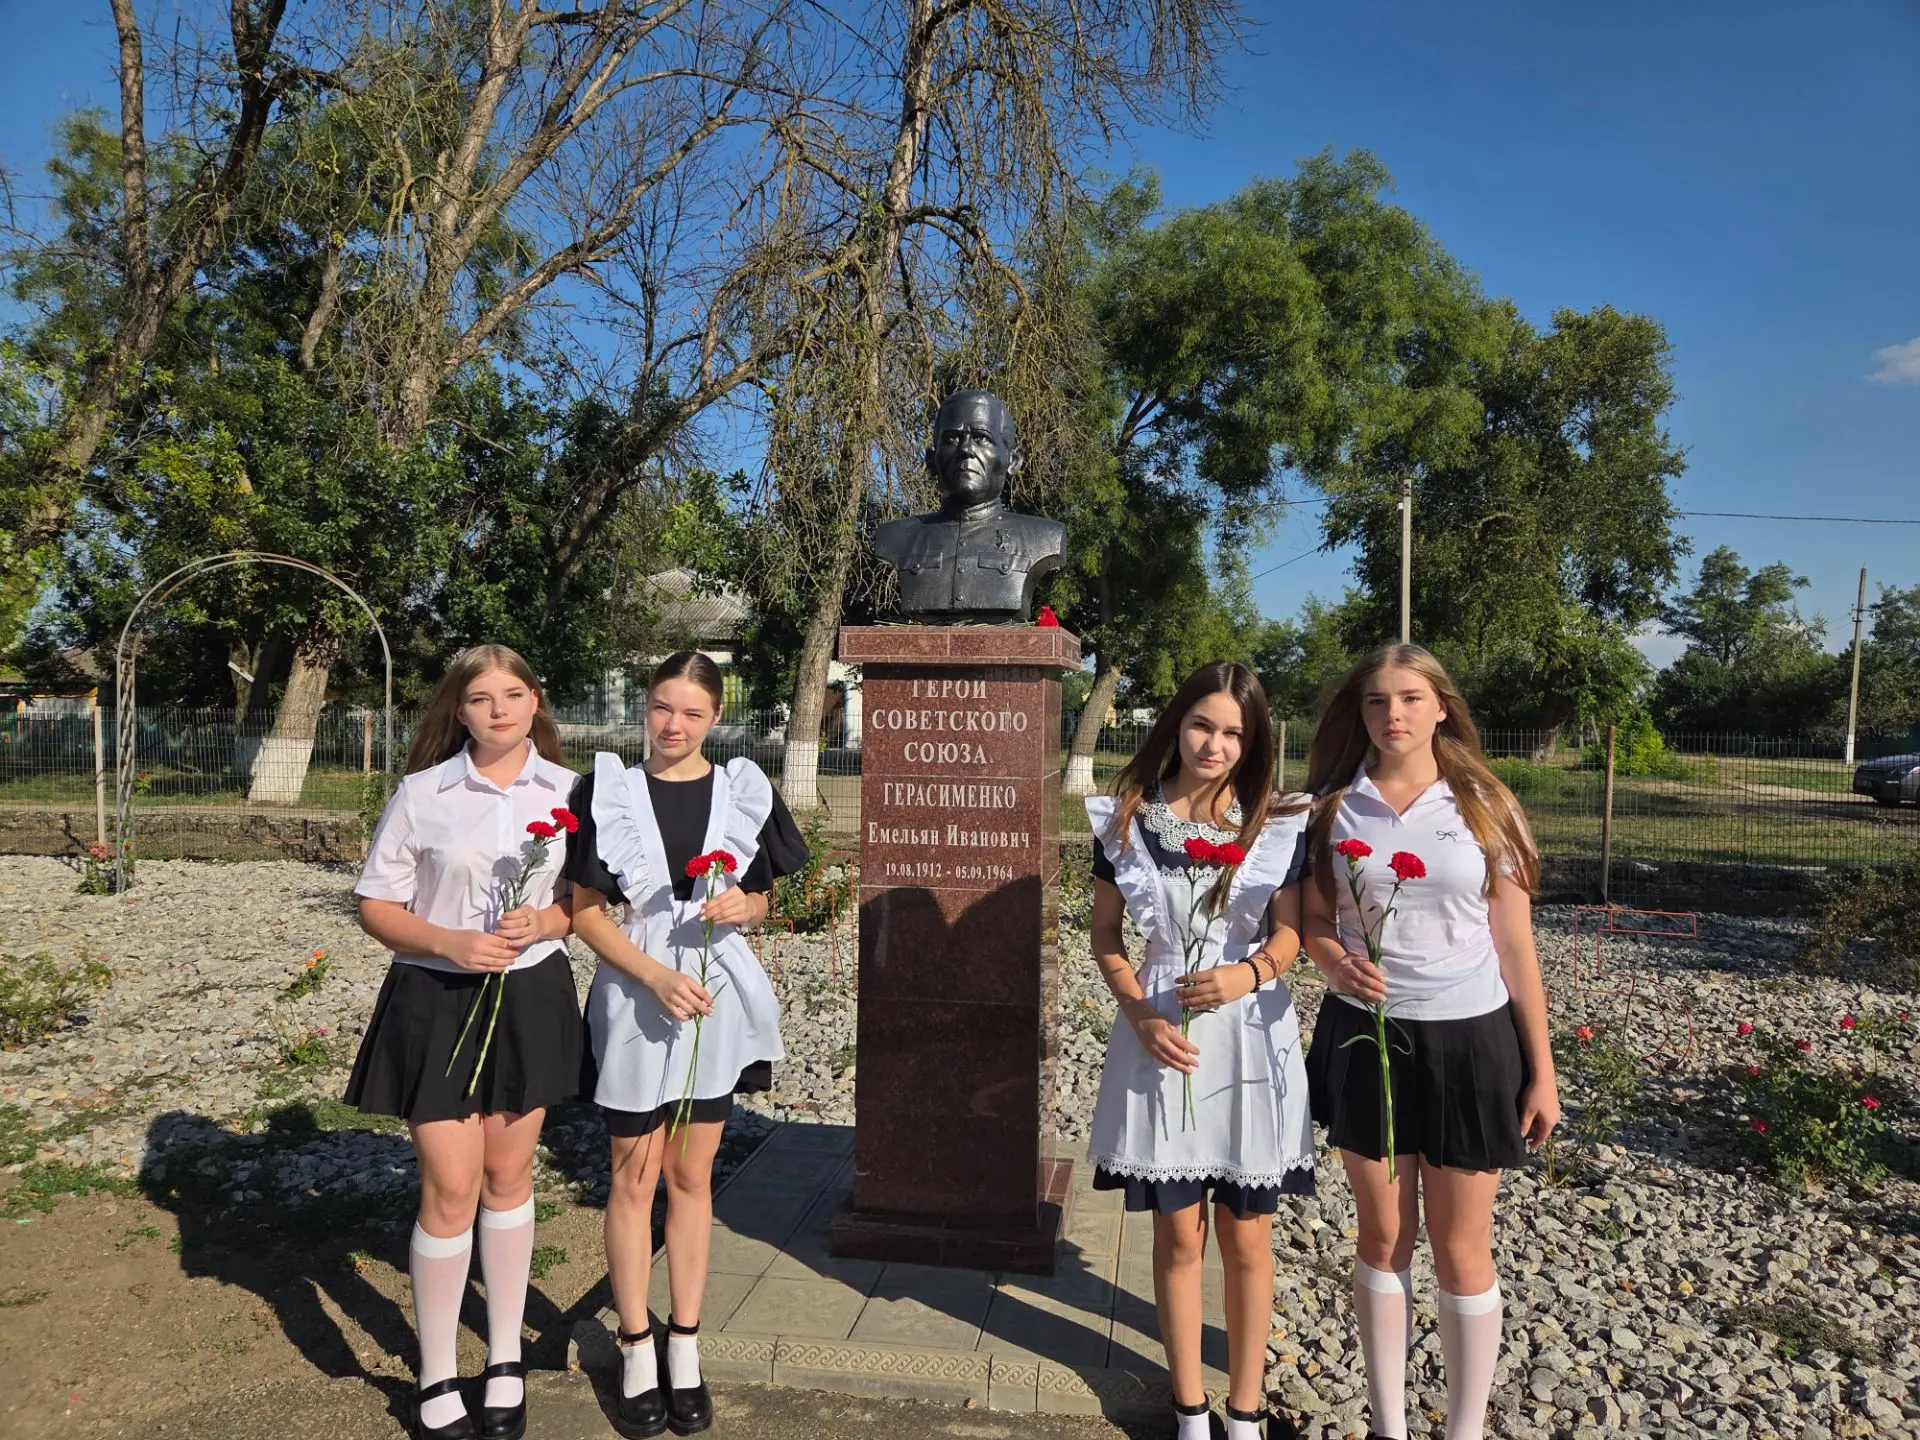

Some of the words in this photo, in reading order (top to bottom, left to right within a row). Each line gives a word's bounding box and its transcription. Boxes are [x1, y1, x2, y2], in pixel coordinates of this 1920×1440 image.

[871, 709, 1028, 733] СОВЕТСКОГО
[903, 742, 988, 764] СОЮЗА
[883, 782, 1017, 809] ГЕРАСИМЕНКО
[867, 821, 940, 845] Емельян
[946, 824, 1030, 848] Иванович
[885, 862, 942, 878] 19.08.1912
[955, 865, 1013, 880] 05.09.1964
